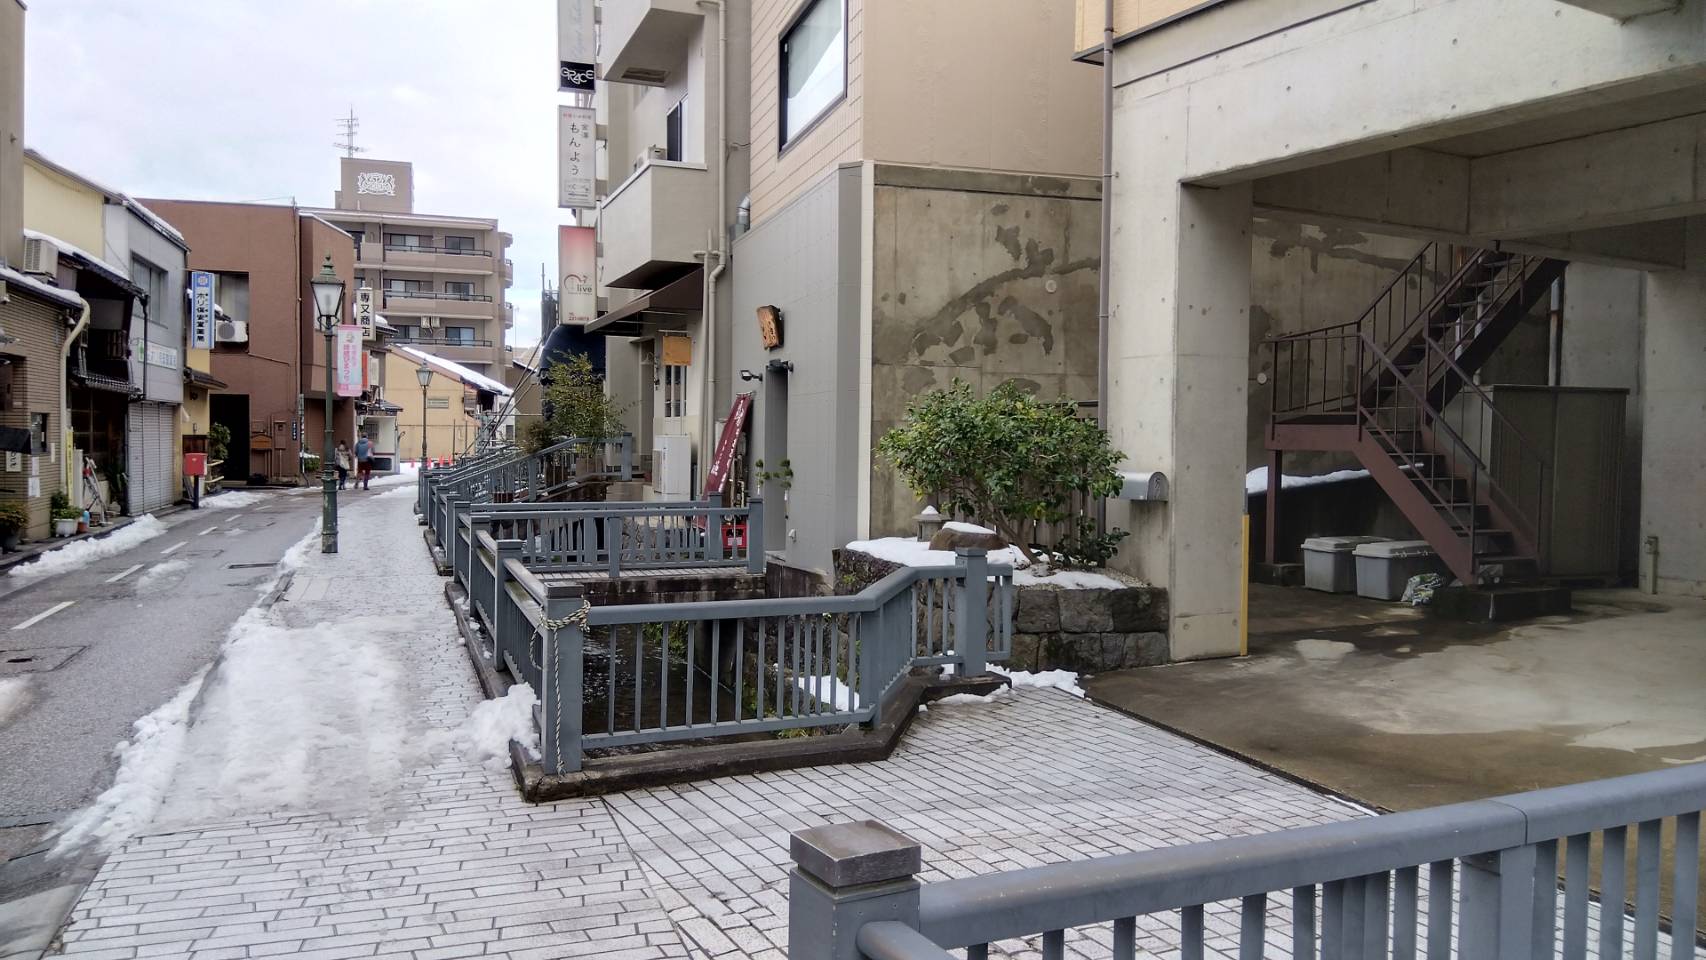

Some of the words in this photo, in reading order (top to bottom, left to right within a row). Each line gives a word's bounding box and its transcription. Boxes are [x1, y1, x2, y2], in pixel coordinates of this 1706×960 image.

[561, 67, 594, 84] GRACE
[569, 122, 581, 175] もんよう
